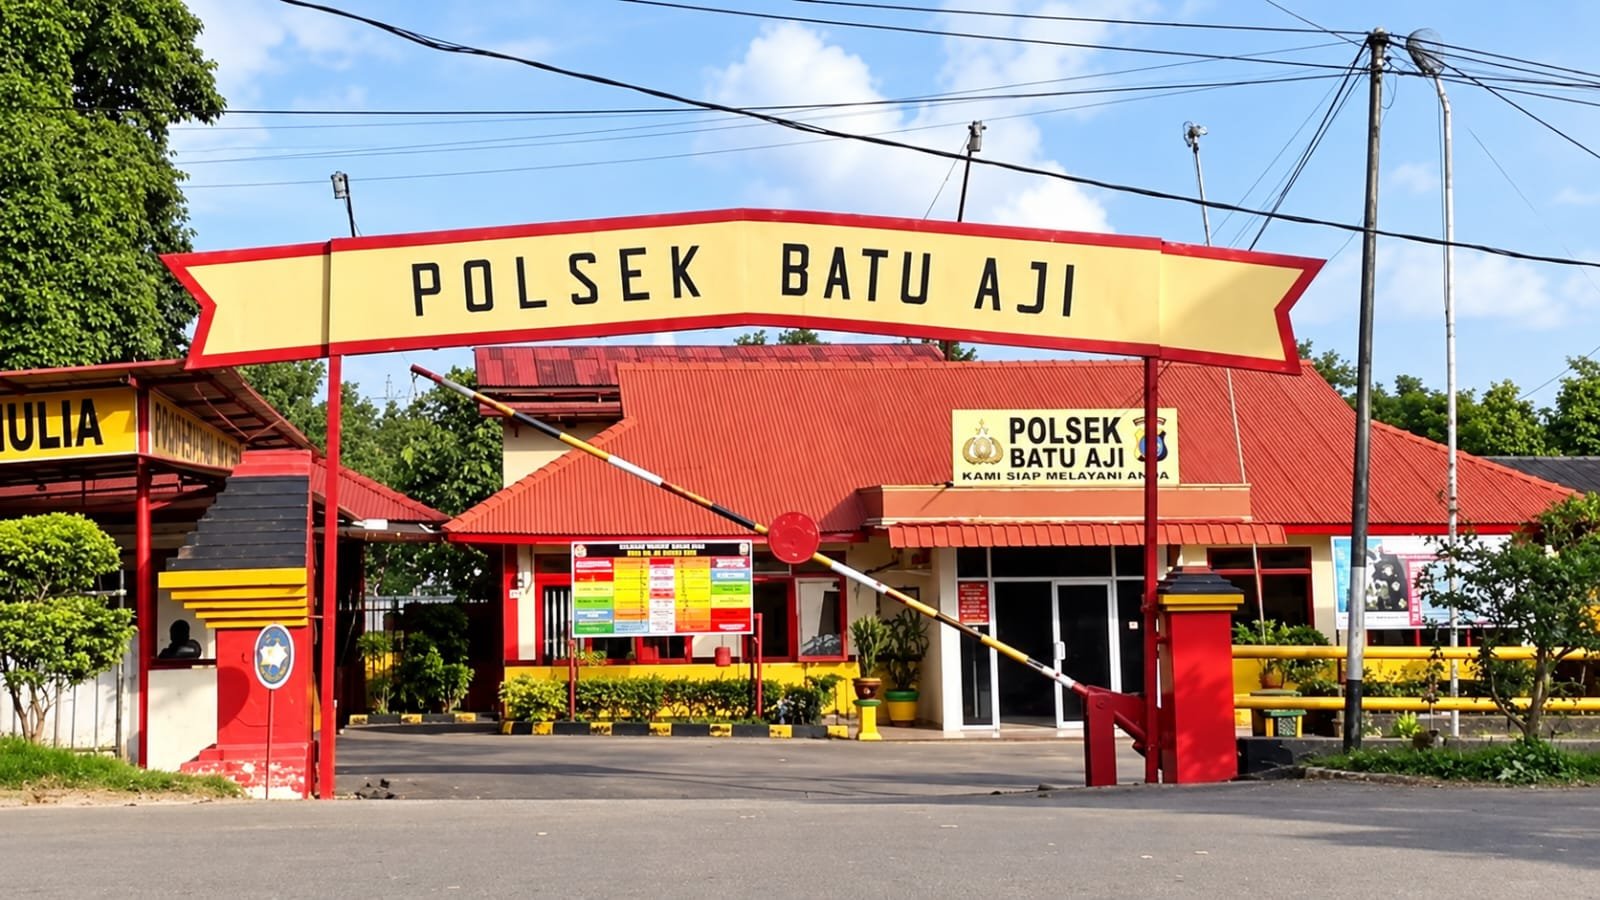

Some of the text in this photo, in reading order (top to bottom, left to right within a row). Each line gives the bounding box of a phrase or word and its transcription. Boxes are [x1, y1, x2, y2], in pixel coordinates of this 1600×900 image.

[411, 242, 1075, 317] POLSEK BATU AJI
[0, 398, 104, 453] ULIA
[1009, 416, 1122, 445] POLSEK
[1010, 447, 1124, 468] BATU AJI
[962, 471, 1169, 481] KAMI SIAP MELAYANI ANA
